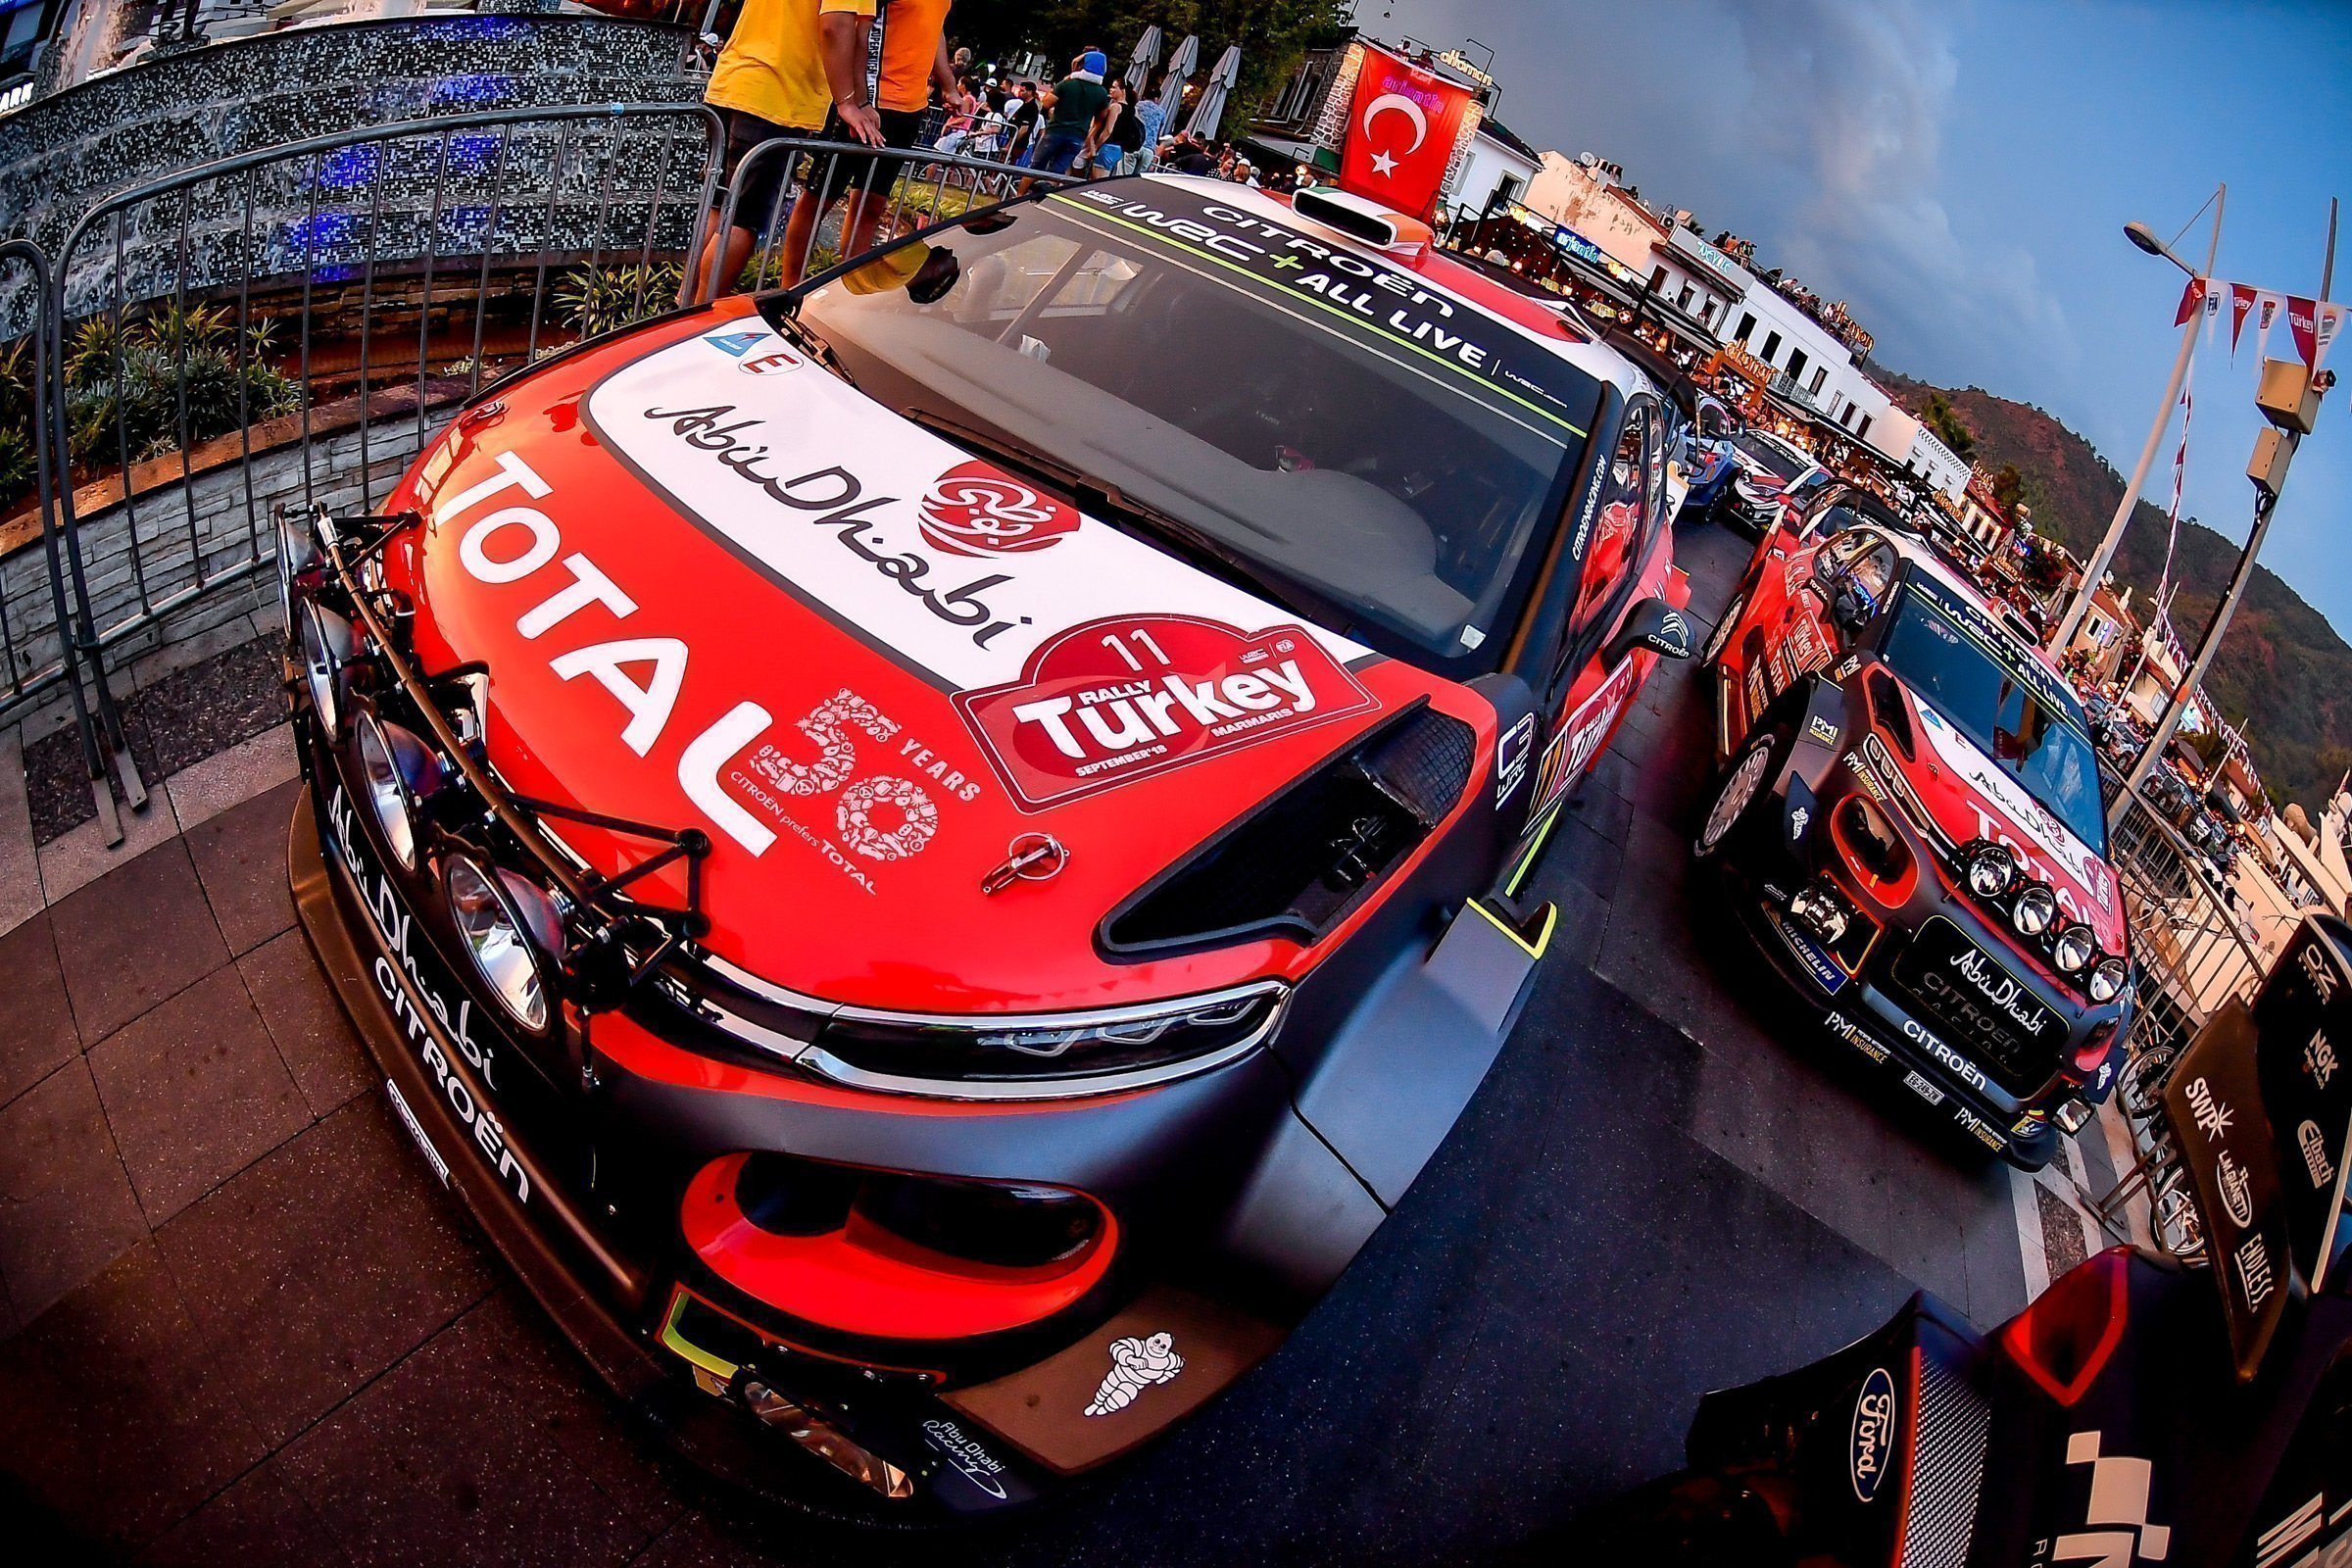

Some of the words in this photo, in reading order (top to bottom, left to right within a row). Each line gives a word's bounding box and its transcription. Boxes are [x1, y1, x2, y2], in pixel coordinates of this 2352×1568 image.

[1202, 206, 1455, 318] CITROËN
[1295, 273, 1375, 317] ALL
[1389, 311, 1488, 369] LIVE
[743, 354, 800, 373] E
[644, 405, 777, 484] Abu
[763, 466, 1033, 651] Dhabi
[1810, 578, 1829, 601] TOTAL
[434, 450, 779, 858] TOTAL
[1101, 628, 1173, 672] 11
[1647, 633, 1690, 659] CITROËN
[1012, 659, 1317, 759] Turkey
[1078, 679, 1152, 707] RALLY
[2017, 663, 2041, 691] ALL
[2042, 684, 2069, 717] LIVE
[1210, 707, 1295, 738] MARMARIS
[1811, 715, 1839, 739] PMI
[900, 738, 981, 802] YEARS
[1074, 744, 1168, 778] SEPTEMBER'18
[1842, 751, 1867, 775] PMI
[730, 770, 784, 817] CITROËN
[780, 812, 819, 848] prefers
[820, 838, 878, 897] TOTAL
[327, 785, 380, 917] Abu
[371, 872, 498, 1090] Dhabi
[1782, 921, 1837, 981] MICHELIN
[1949, 949, 1993, 997] Abu
[1991, 978, 2048, 1037] Dhabi
[1824, 1011, 1857, 1040] PMI
[1849, 1034, 1888, 1065] INSURANCE
[1903, 1019, 1987, 1092] CITROËN
[2309, 1027, 2339, 1083] NGK
[374, 956, 529, 1204] CITROËN
[1908, 1075, 1940, 1102] EG-249-ZW
[2184, 1077, 2220, 1131] SWP
[1954, 1106, 1983, 1133] PMI
[1974, 1127, 2004, 1153] INSURANCE
[2297, 1119, 2334, 1185] Eibach
[2240, 1232, 2275, 1305] ENDLESS
[923, 1419, 991, 1477] Racing
[940, 1422, 967, 1445] Abu
[965, 1442, 1006, 1474] Dhabi
[1857, 1394, 1891, 1480] Ford
